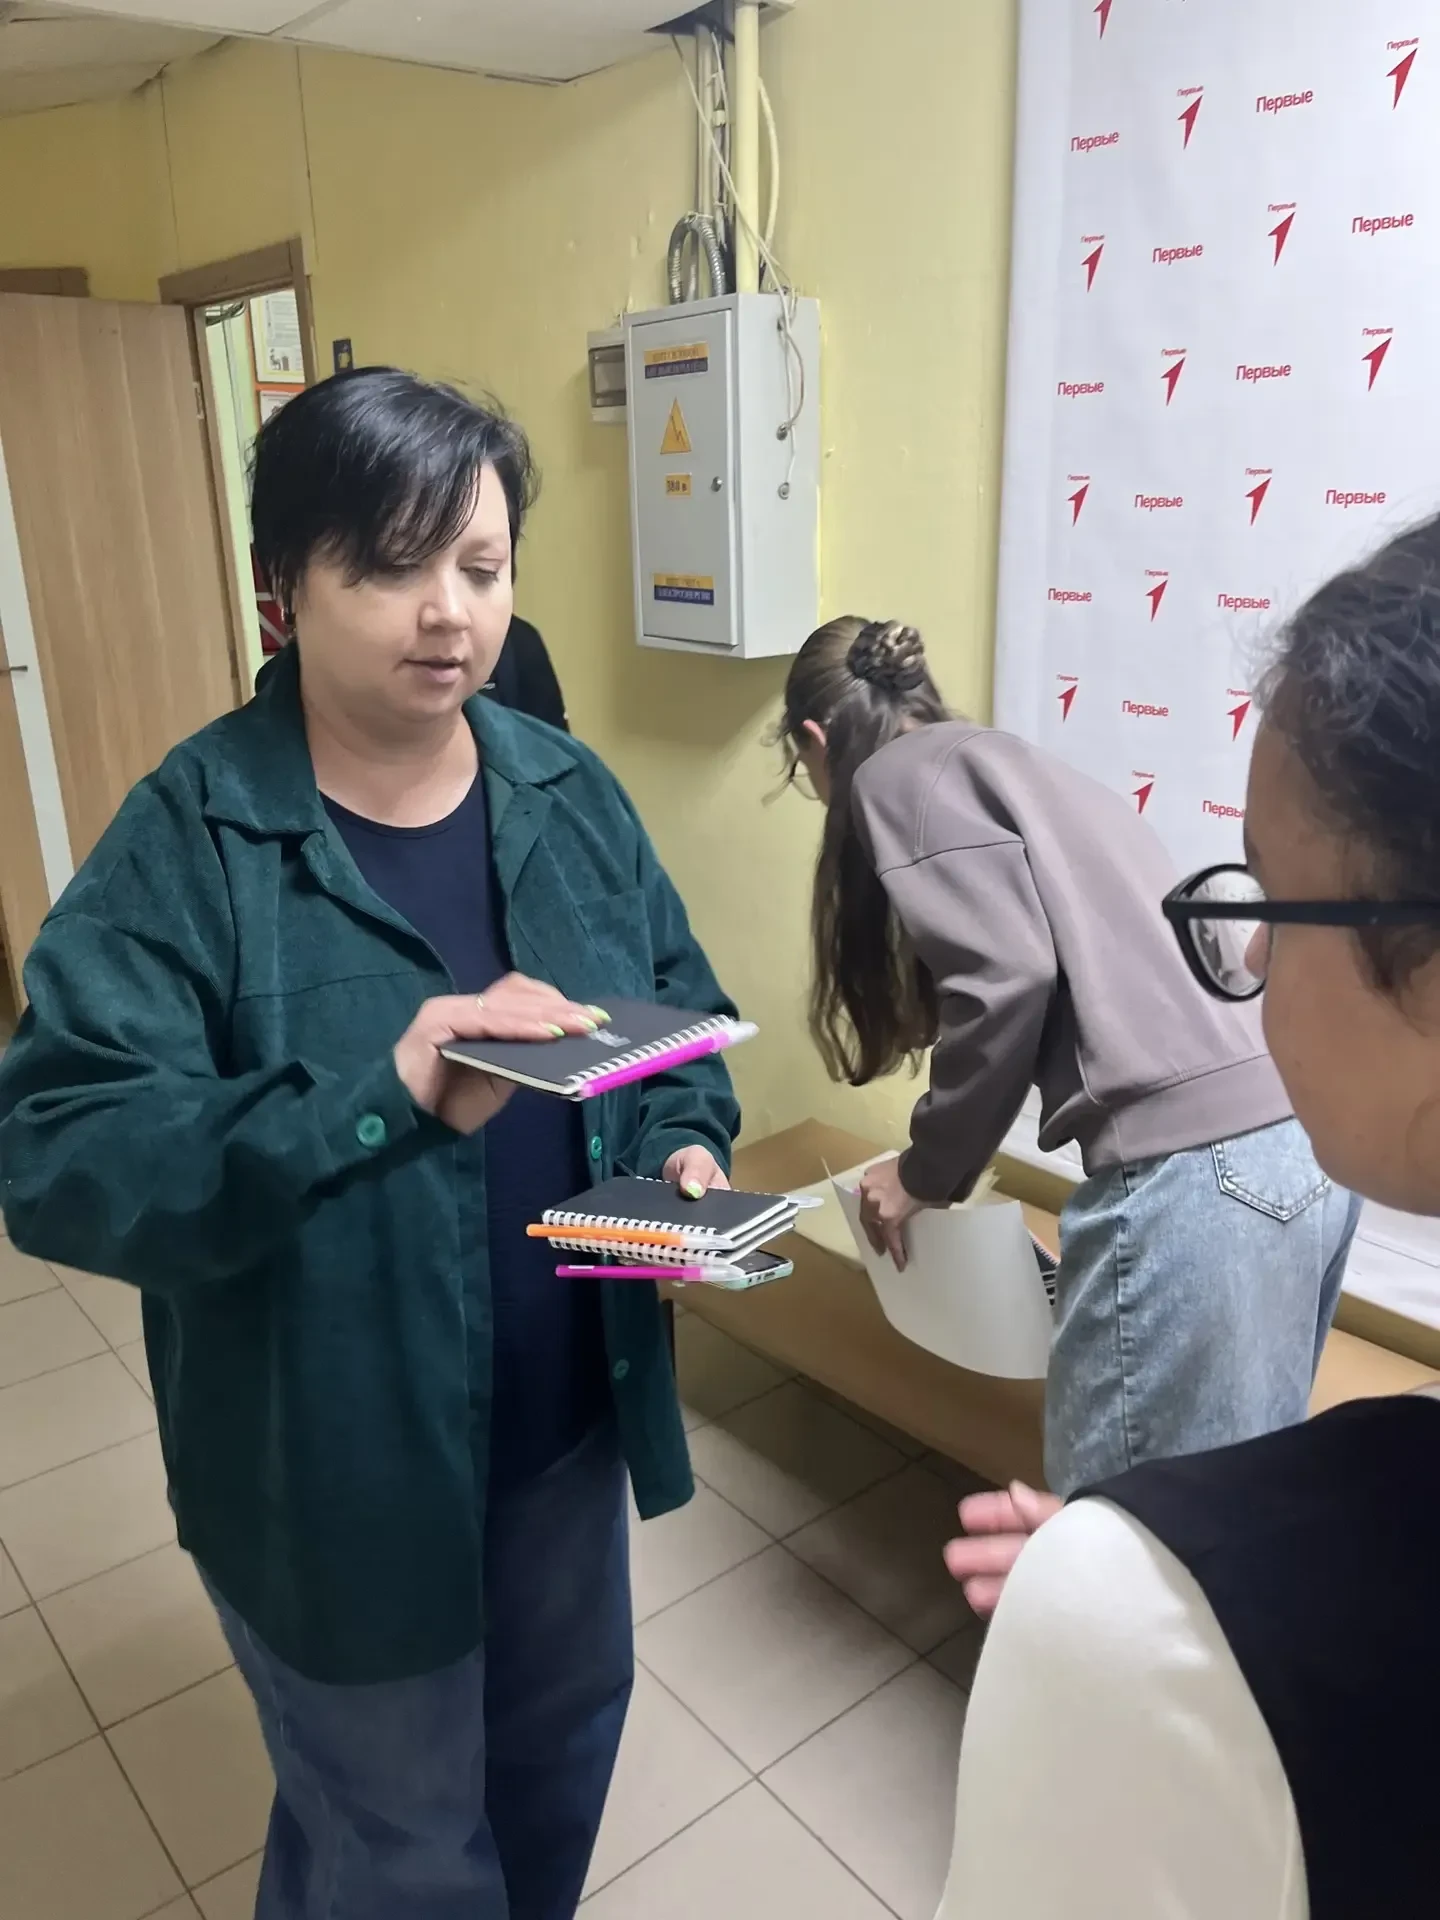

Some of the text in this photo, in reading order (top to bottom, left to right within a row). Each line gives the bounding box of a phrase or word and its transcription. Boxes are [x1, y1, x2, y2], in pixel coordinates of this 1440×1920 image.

[1256, 89, 1313, 114] Первые
[1071, 131, 1120, 152] Первые
[1352, 211, 1414, 236] Первые
[1152, 243, 1203, 265] Первые
[1236, 363, 1292, 383] Первые
[1057, 380, 1105, 398] Первые
[1134, 494, 1183, 511] Первые
[1325, 489, 1387, 508] Первые
[1048, 588, 1092, 604] Первые
[1217, 594, 1270, 610] Первые
[1122, 700, 1169, 717] Первые
[1202, 799, 1245, 819] Первы
